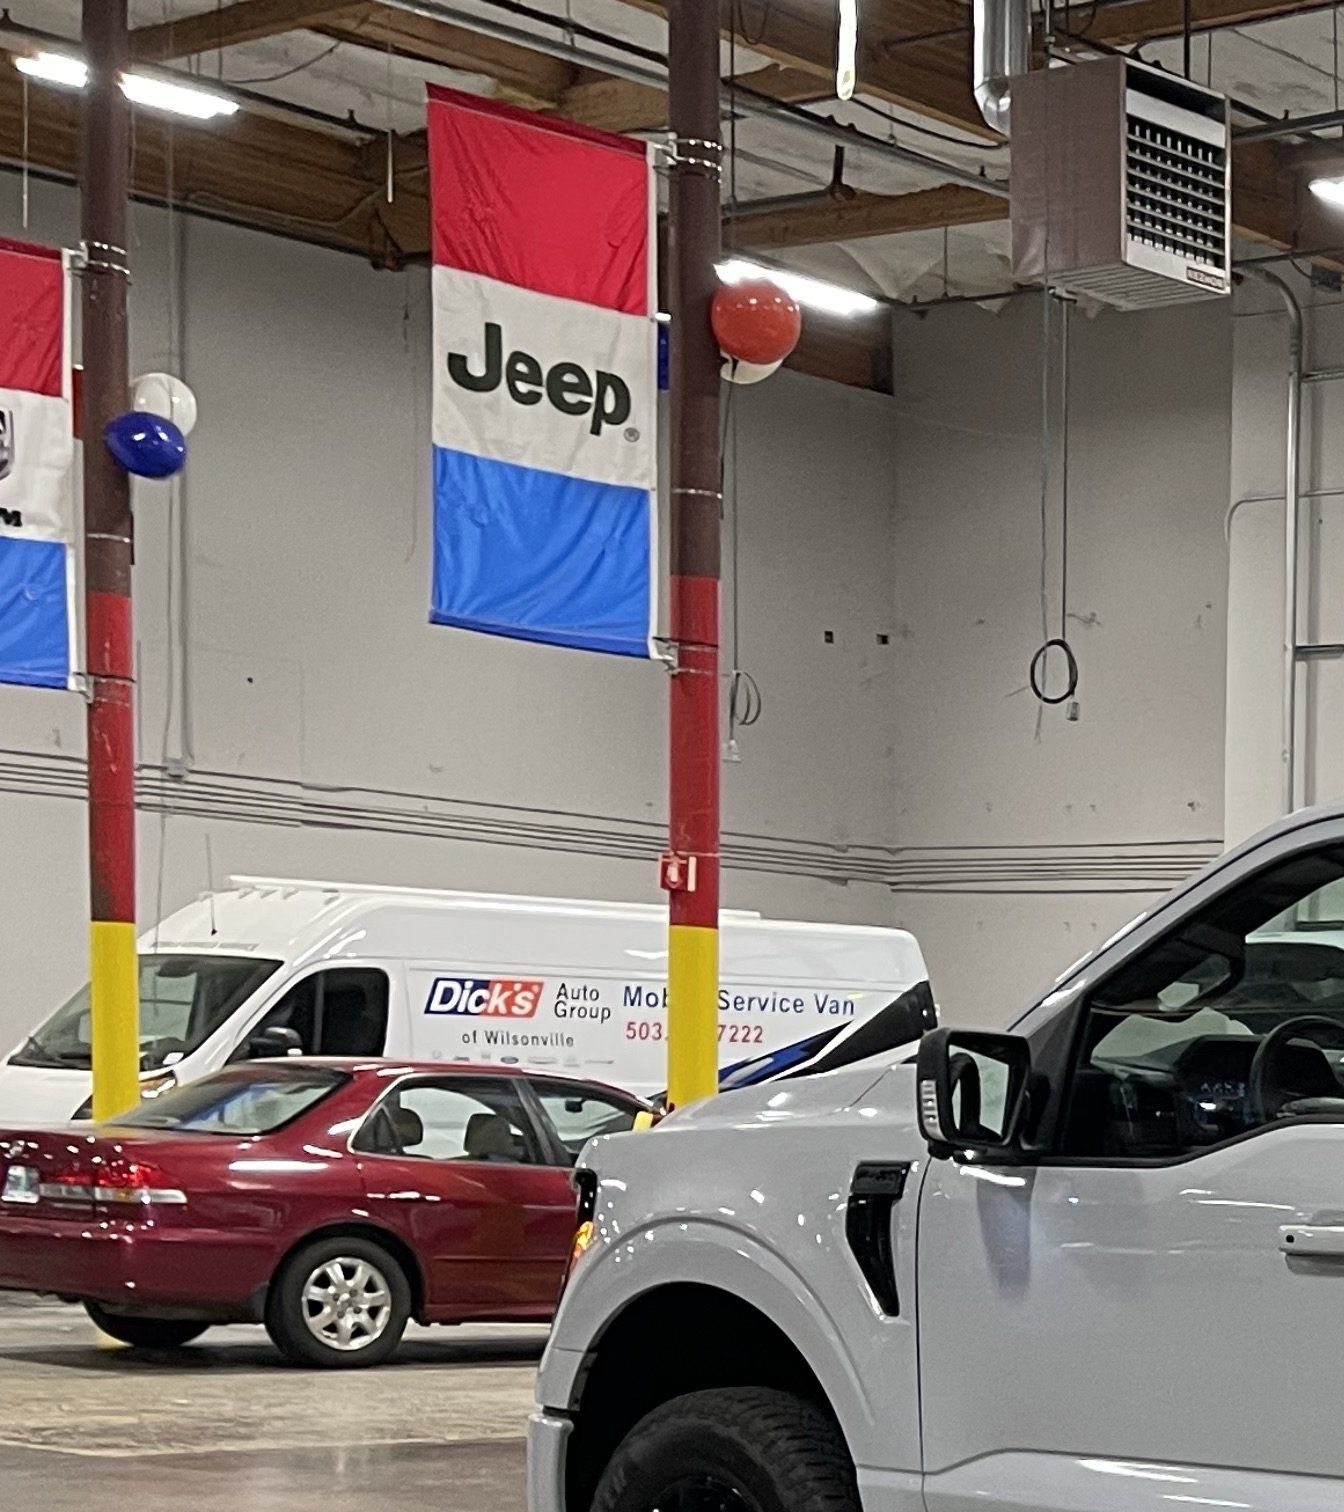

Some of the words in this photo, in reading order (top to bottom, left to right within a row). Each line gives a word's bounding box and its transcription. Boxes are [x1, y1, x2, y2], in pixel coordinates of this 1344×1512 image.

[447, 322, 631, 436] Jeep
[556, 983, 600, 1001] Auto
[554, 1001, 611, 1024] Group
[718, 989, 805, 1014] Service
[814, 993, 855, 1016] Van
[462, 1030, 477, 1044] of
[484, 1030, 574, 1047] Wilsonville
